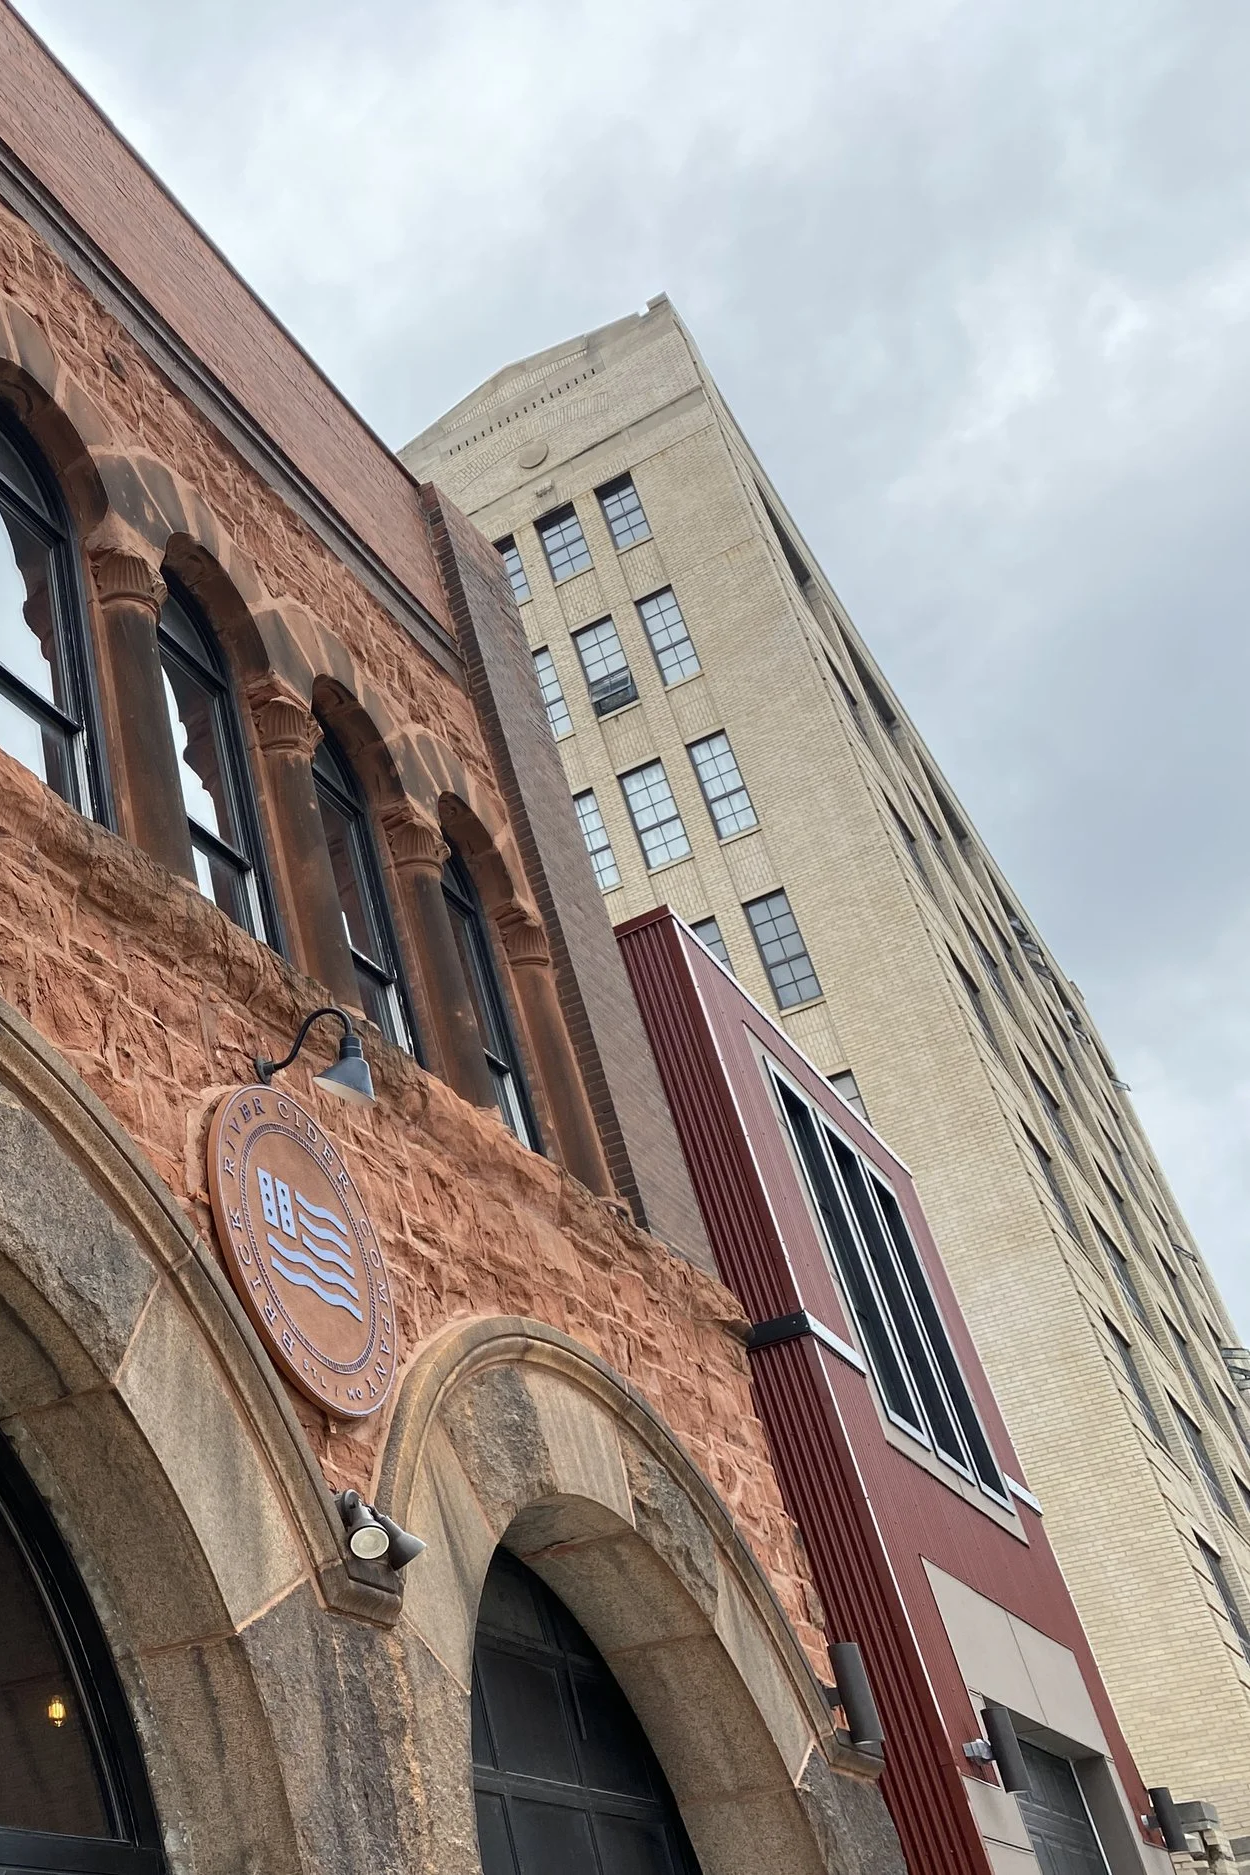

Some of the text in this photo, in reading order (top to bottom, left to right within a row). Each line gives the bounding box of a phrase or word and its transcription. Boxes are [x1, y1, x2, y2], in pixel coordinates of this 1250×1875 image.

[223, 1096, 391, 1398] BRICK RIVER CIDER COMPANY
[303, 1359, 363, 1400] STL MO
